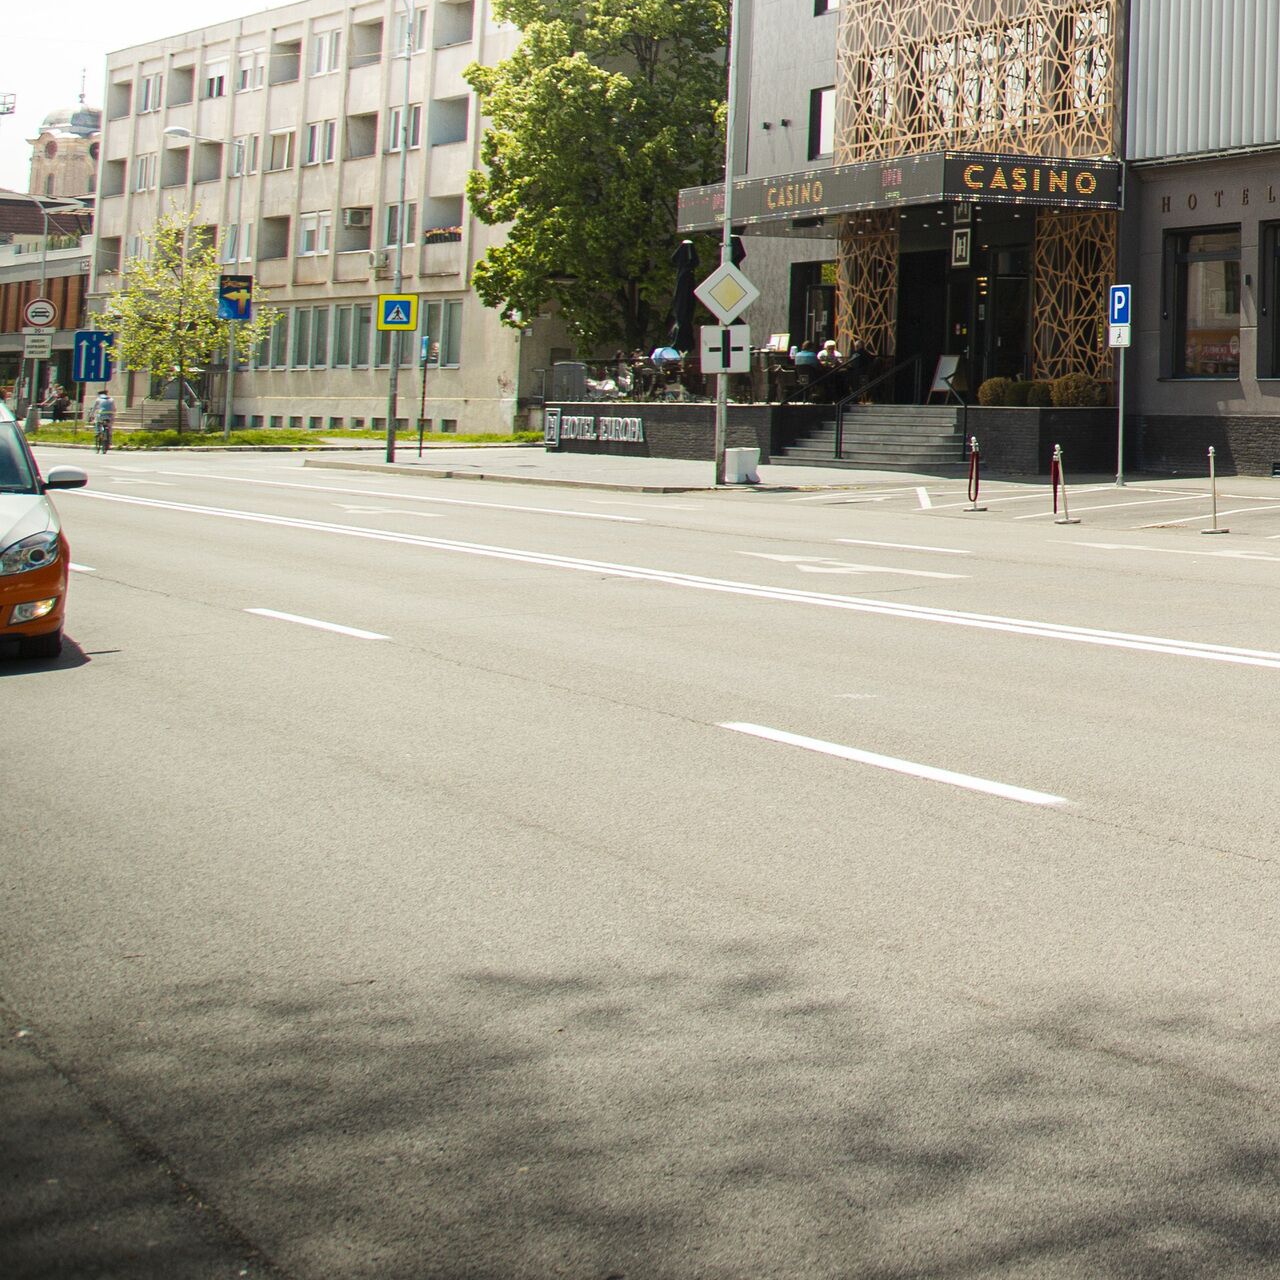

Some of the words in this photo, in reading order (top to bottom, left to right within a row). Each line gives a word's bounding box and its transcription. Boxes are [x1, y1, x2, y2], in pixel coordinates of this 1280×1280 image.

[962, 164, 1097, 195] CASINO
[766, 180, 824, 210] CASINO
[1161, 184, 1277, 214] HOTEL
[1113, 290, 1126, 320] P
[560, 415, 598, 441] HOTEL
[599, 416, 645, 443] EUROPA
